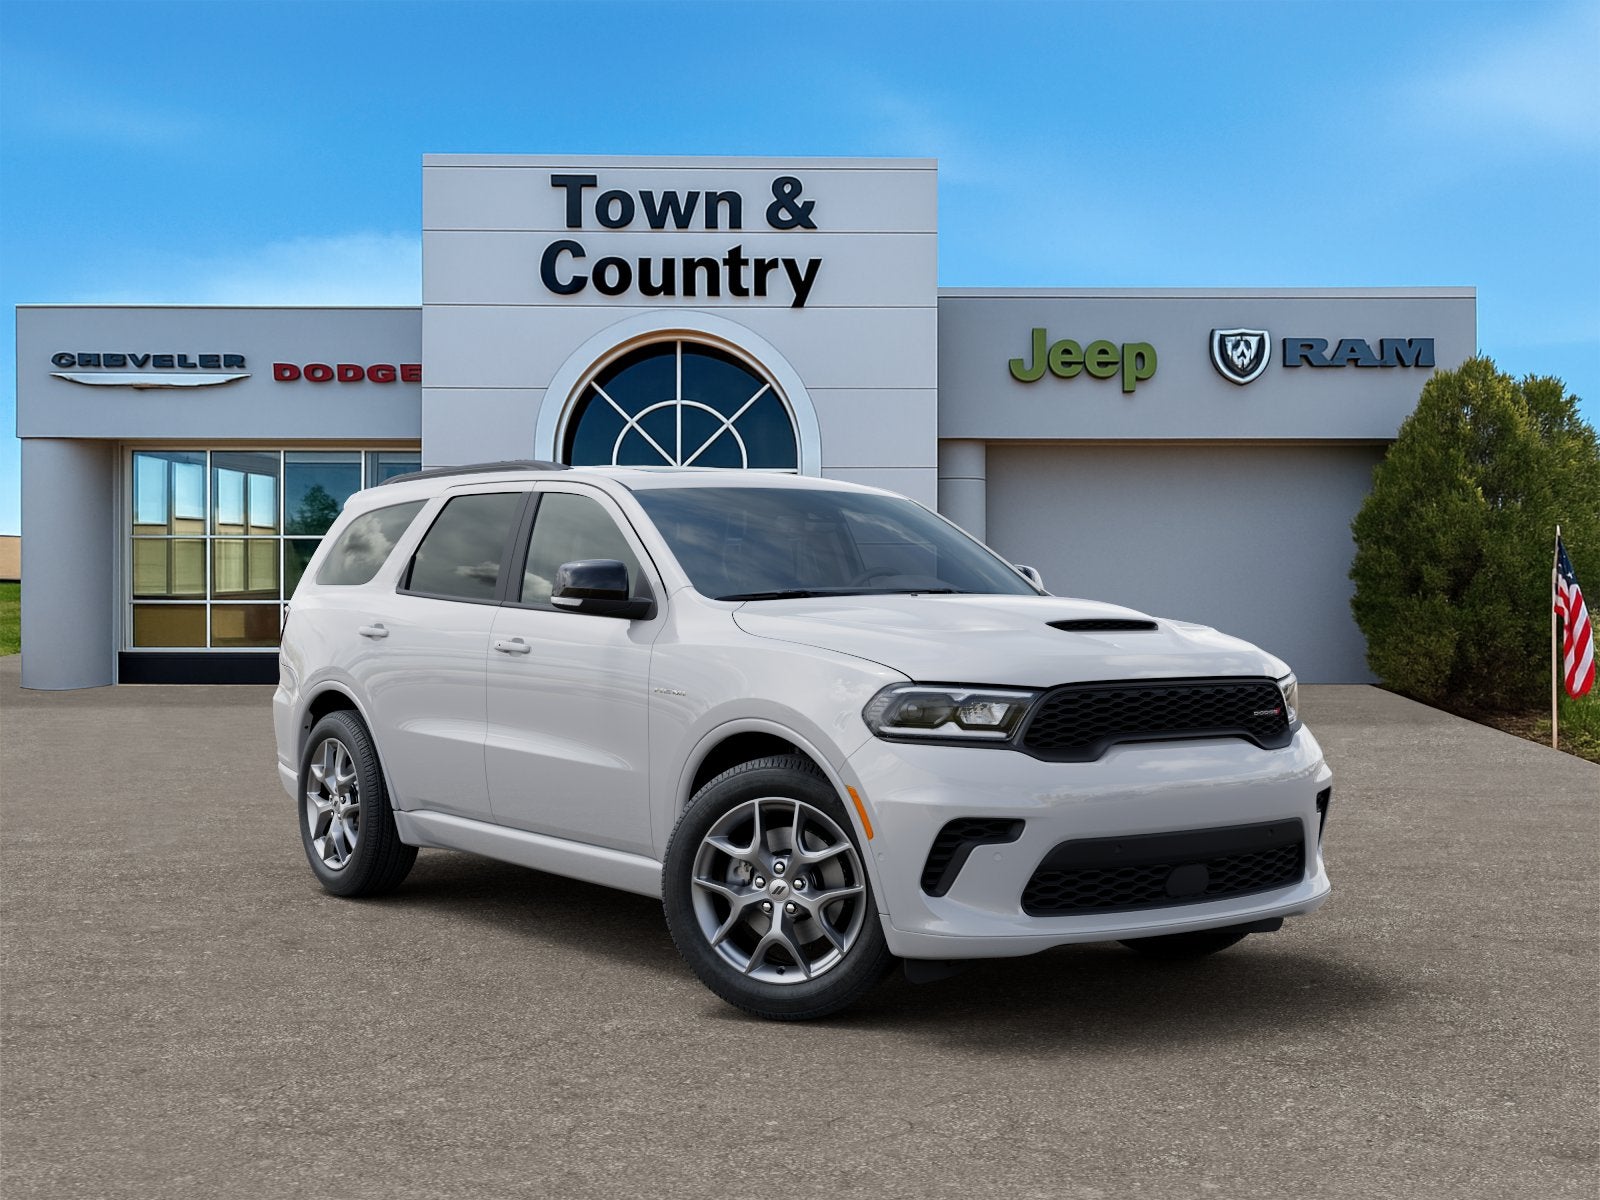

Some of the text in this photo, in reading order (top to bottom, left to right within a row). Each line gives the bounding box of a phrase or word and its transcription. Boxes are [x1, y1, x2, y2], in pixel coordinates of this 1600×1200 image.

[551, 174, 818, 231] Town &
[540, 239, 823, 308] Country
[272, 362, 422, 384] DODGE
[1008, 327, 1158, 394] Jeep
[1282, 337, 1436, 368] RAM
